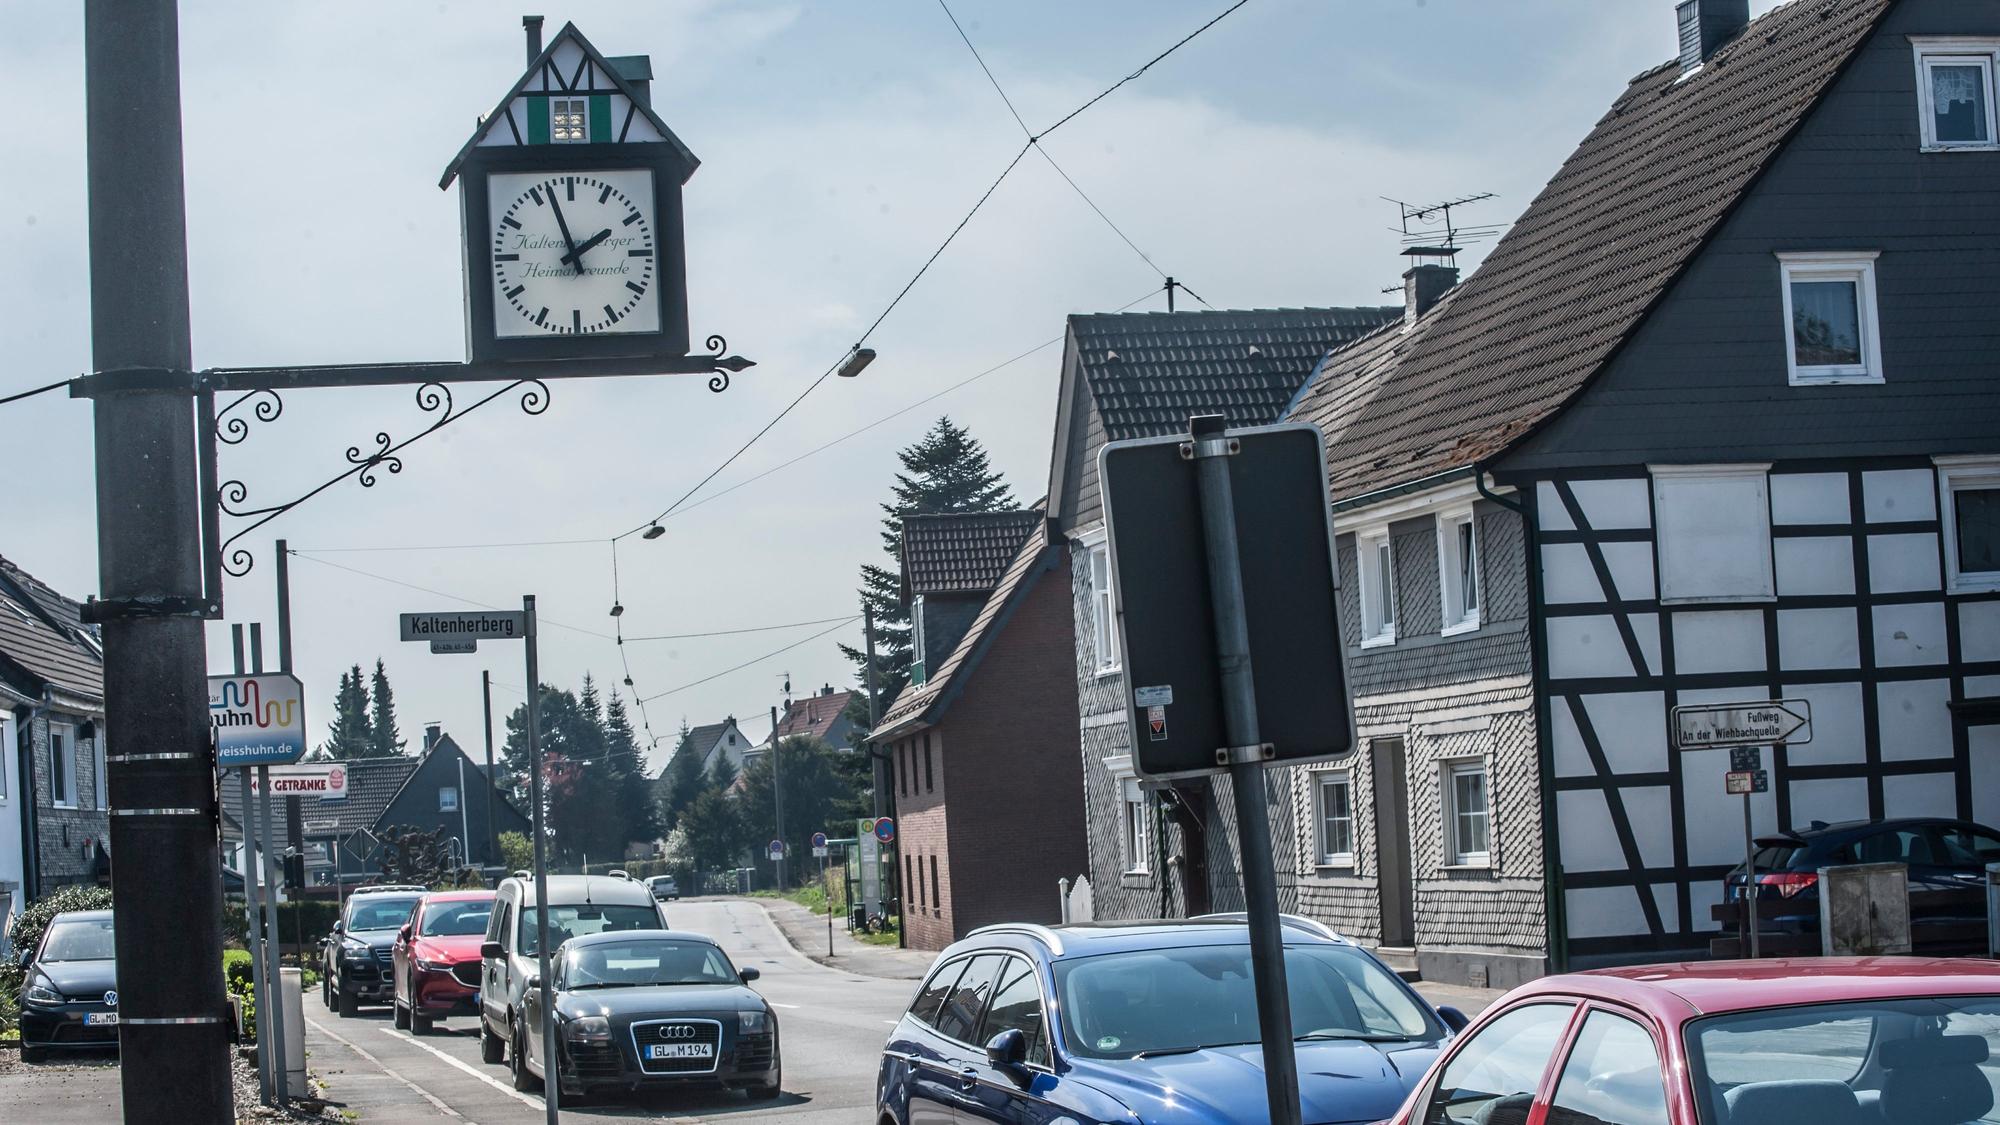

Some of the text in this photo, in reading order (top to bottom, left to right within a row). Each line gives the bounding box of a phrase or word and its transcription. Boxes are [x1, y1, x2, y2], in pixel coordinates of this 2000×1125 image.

[411, 615, 514, 636] Kaltenherberg
[1747, 711, 1779, 724] Fußweg
[1682, 726, 1780, 741] An der Wiehbachquelle
[274, 778, 327, 792] GETRÄNKE
[90, 1014, 101, 1024] GL
[654, 1046, 670, 1057] GL
